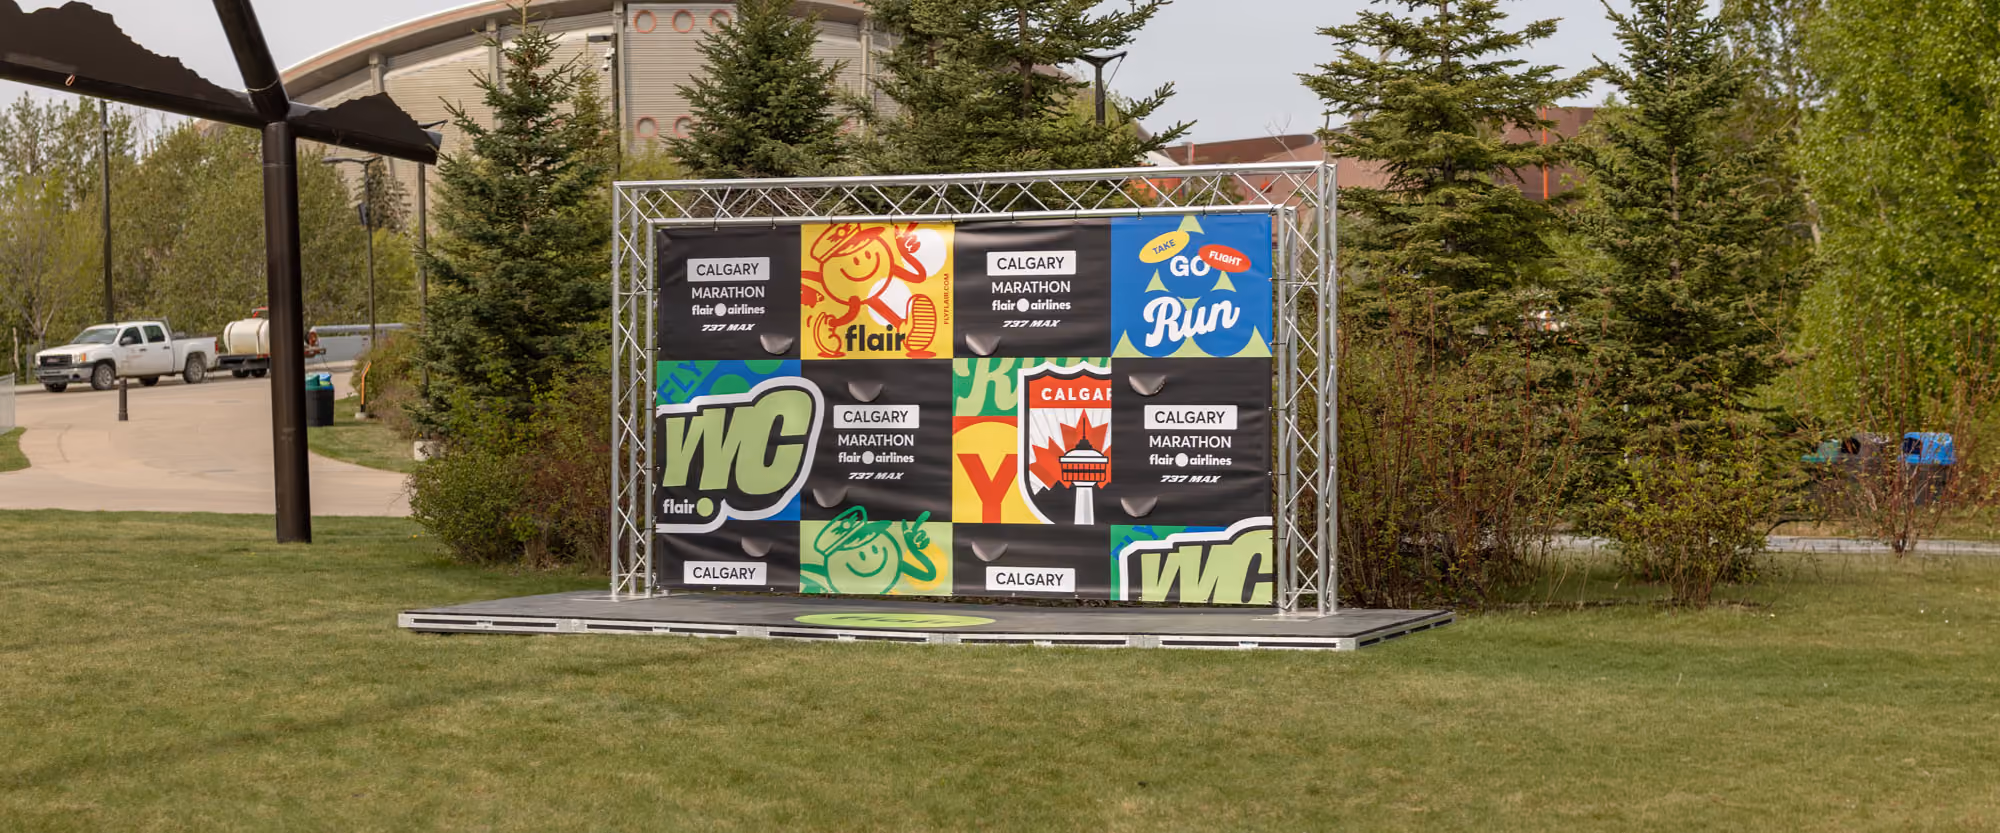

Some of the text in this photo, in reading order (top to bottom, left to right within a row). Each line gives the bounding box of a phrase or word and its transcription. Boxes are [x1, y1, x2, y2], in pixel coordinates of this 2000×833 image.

[1152, 239, 1176, 255] TAKE
[996, 256, 1065, 270] CALGARY
[1208, 250, 1242, 267] FLIGHT
[696, 263, 759, 276] CALGARY
[1170, 255, 1210, 277] GO
[691, 286, 765, 299] MARATHON
[991, 280, 1071, 294] MARATHON
[692, 304, 765, 316] flair airlines
[992, 299, 1071, 311] flair airlines
[701, 323, 756, 332] 737 MAX
[1002, 319, 1060, 328] 737 MAX
[1143, 296, 1240, 347] Run
[845, 324, 906, 352] flair
[657, 360, 702, 404] FLY
[843, 410, 909, 423] CALGARY
[1154, 410, 1226, 424] CALGARY
[838, 434, 914, 447] MARATHON
[1149, 435, 1231, 449] MARATHON
[838, 452, 915, 464] flair airlines
[1150, 453, 1232, 466] flair airlines
[848, 472, 904, 480] 737 MAX
[1160, 475, 1221, 483] 737 MAX
[663, 498, 695, 515] flair
[693, 567, 756, 580] CALGARY
[996, 572, 1064, 586] CALGARY
